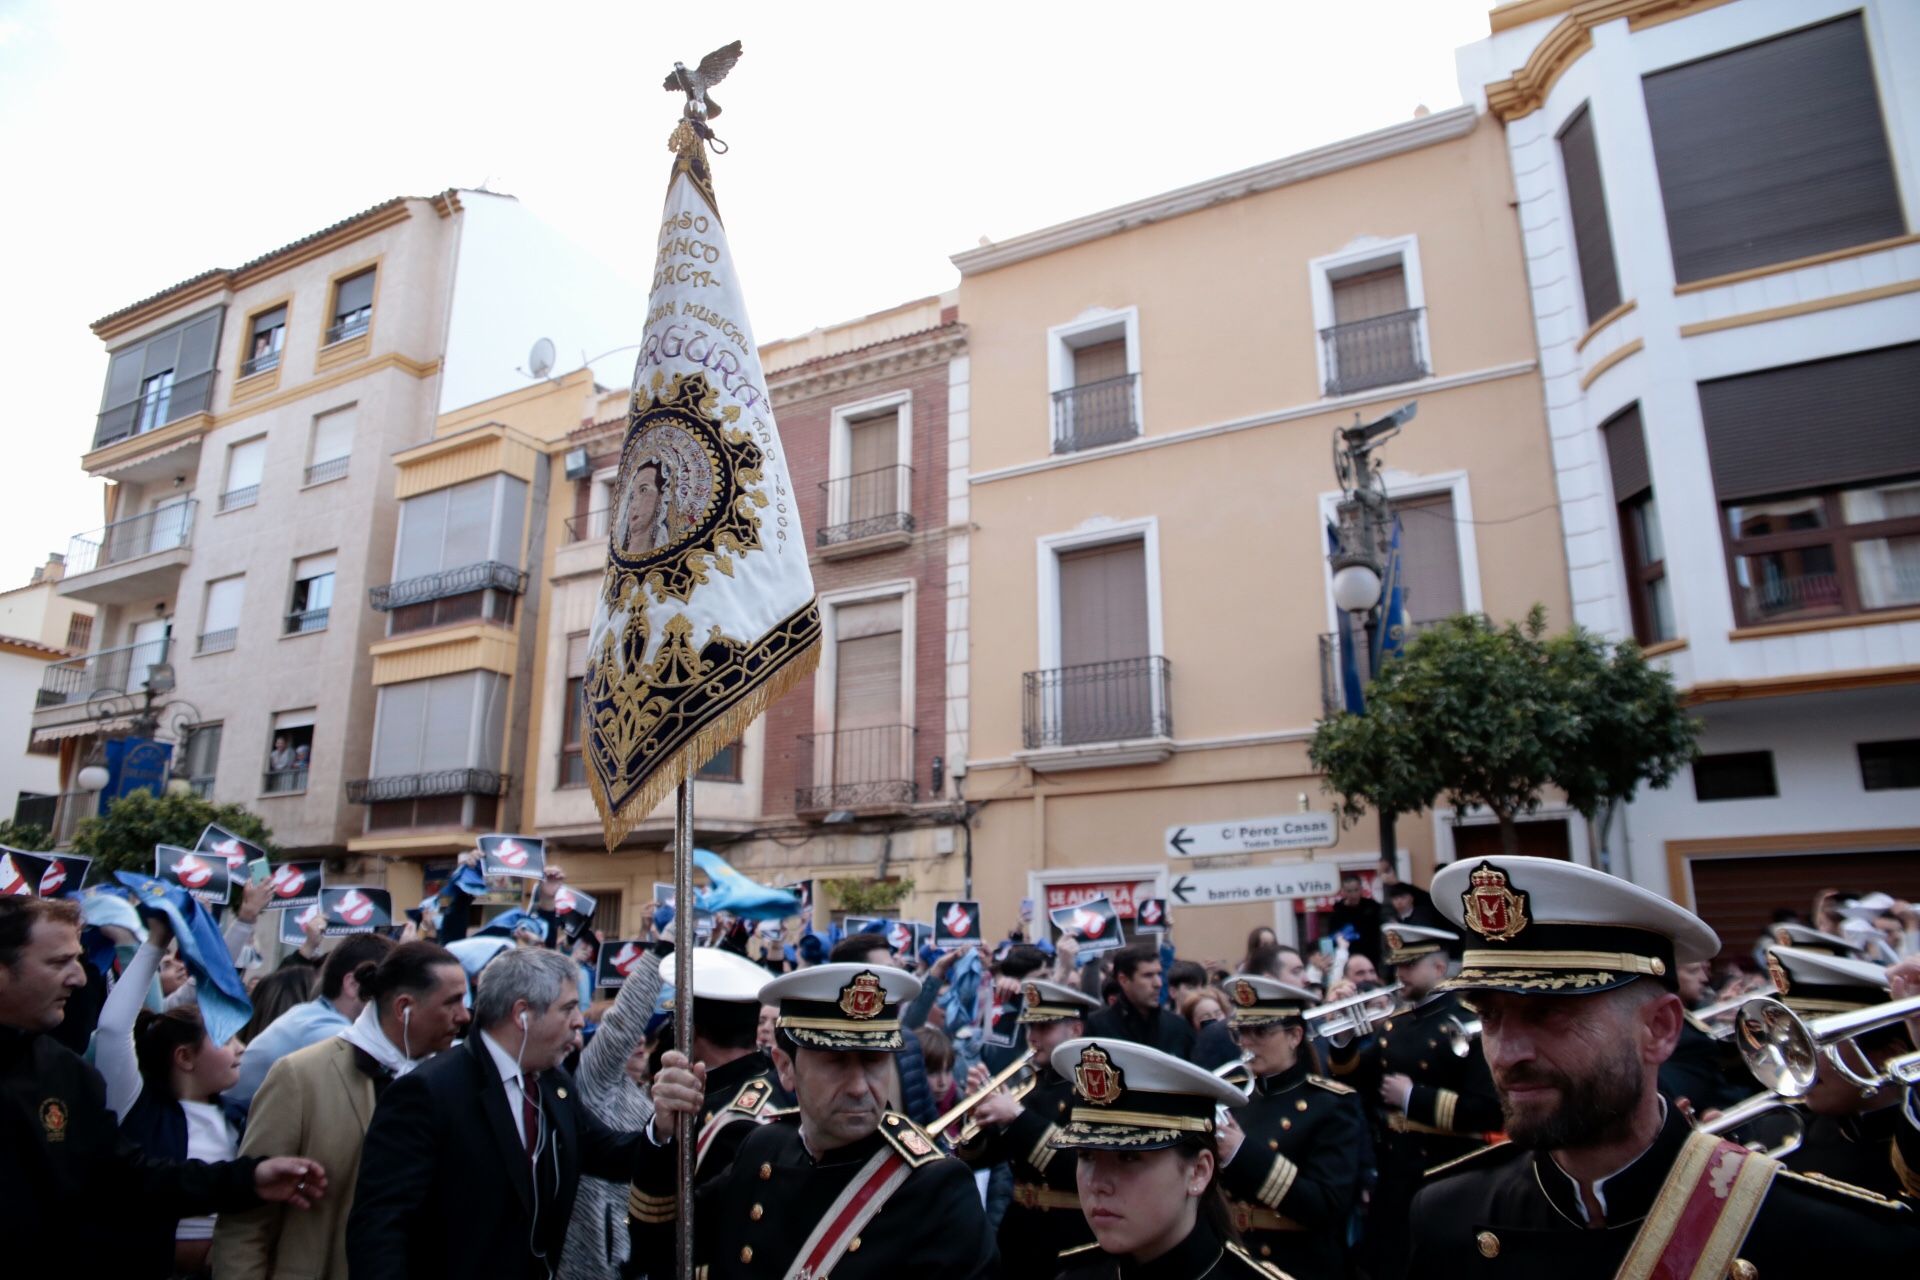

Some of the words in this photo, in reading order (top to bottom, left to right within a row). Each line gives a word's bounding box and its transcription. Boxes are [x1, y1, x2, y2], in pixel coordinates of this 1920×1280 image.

[663, 211, 709, 235] ASO
[660, 237, 720, 263] ANCO
[682, 302, 748, 355] MUSICAL
[1283, 822, 1329, 834] Casas
[1208, 887, 1250, 900] barrio
[1255, 885, 1272, 896] de
[1276, 884, 1294, 895] La
[1299, 881, 1332, 892] Viña
